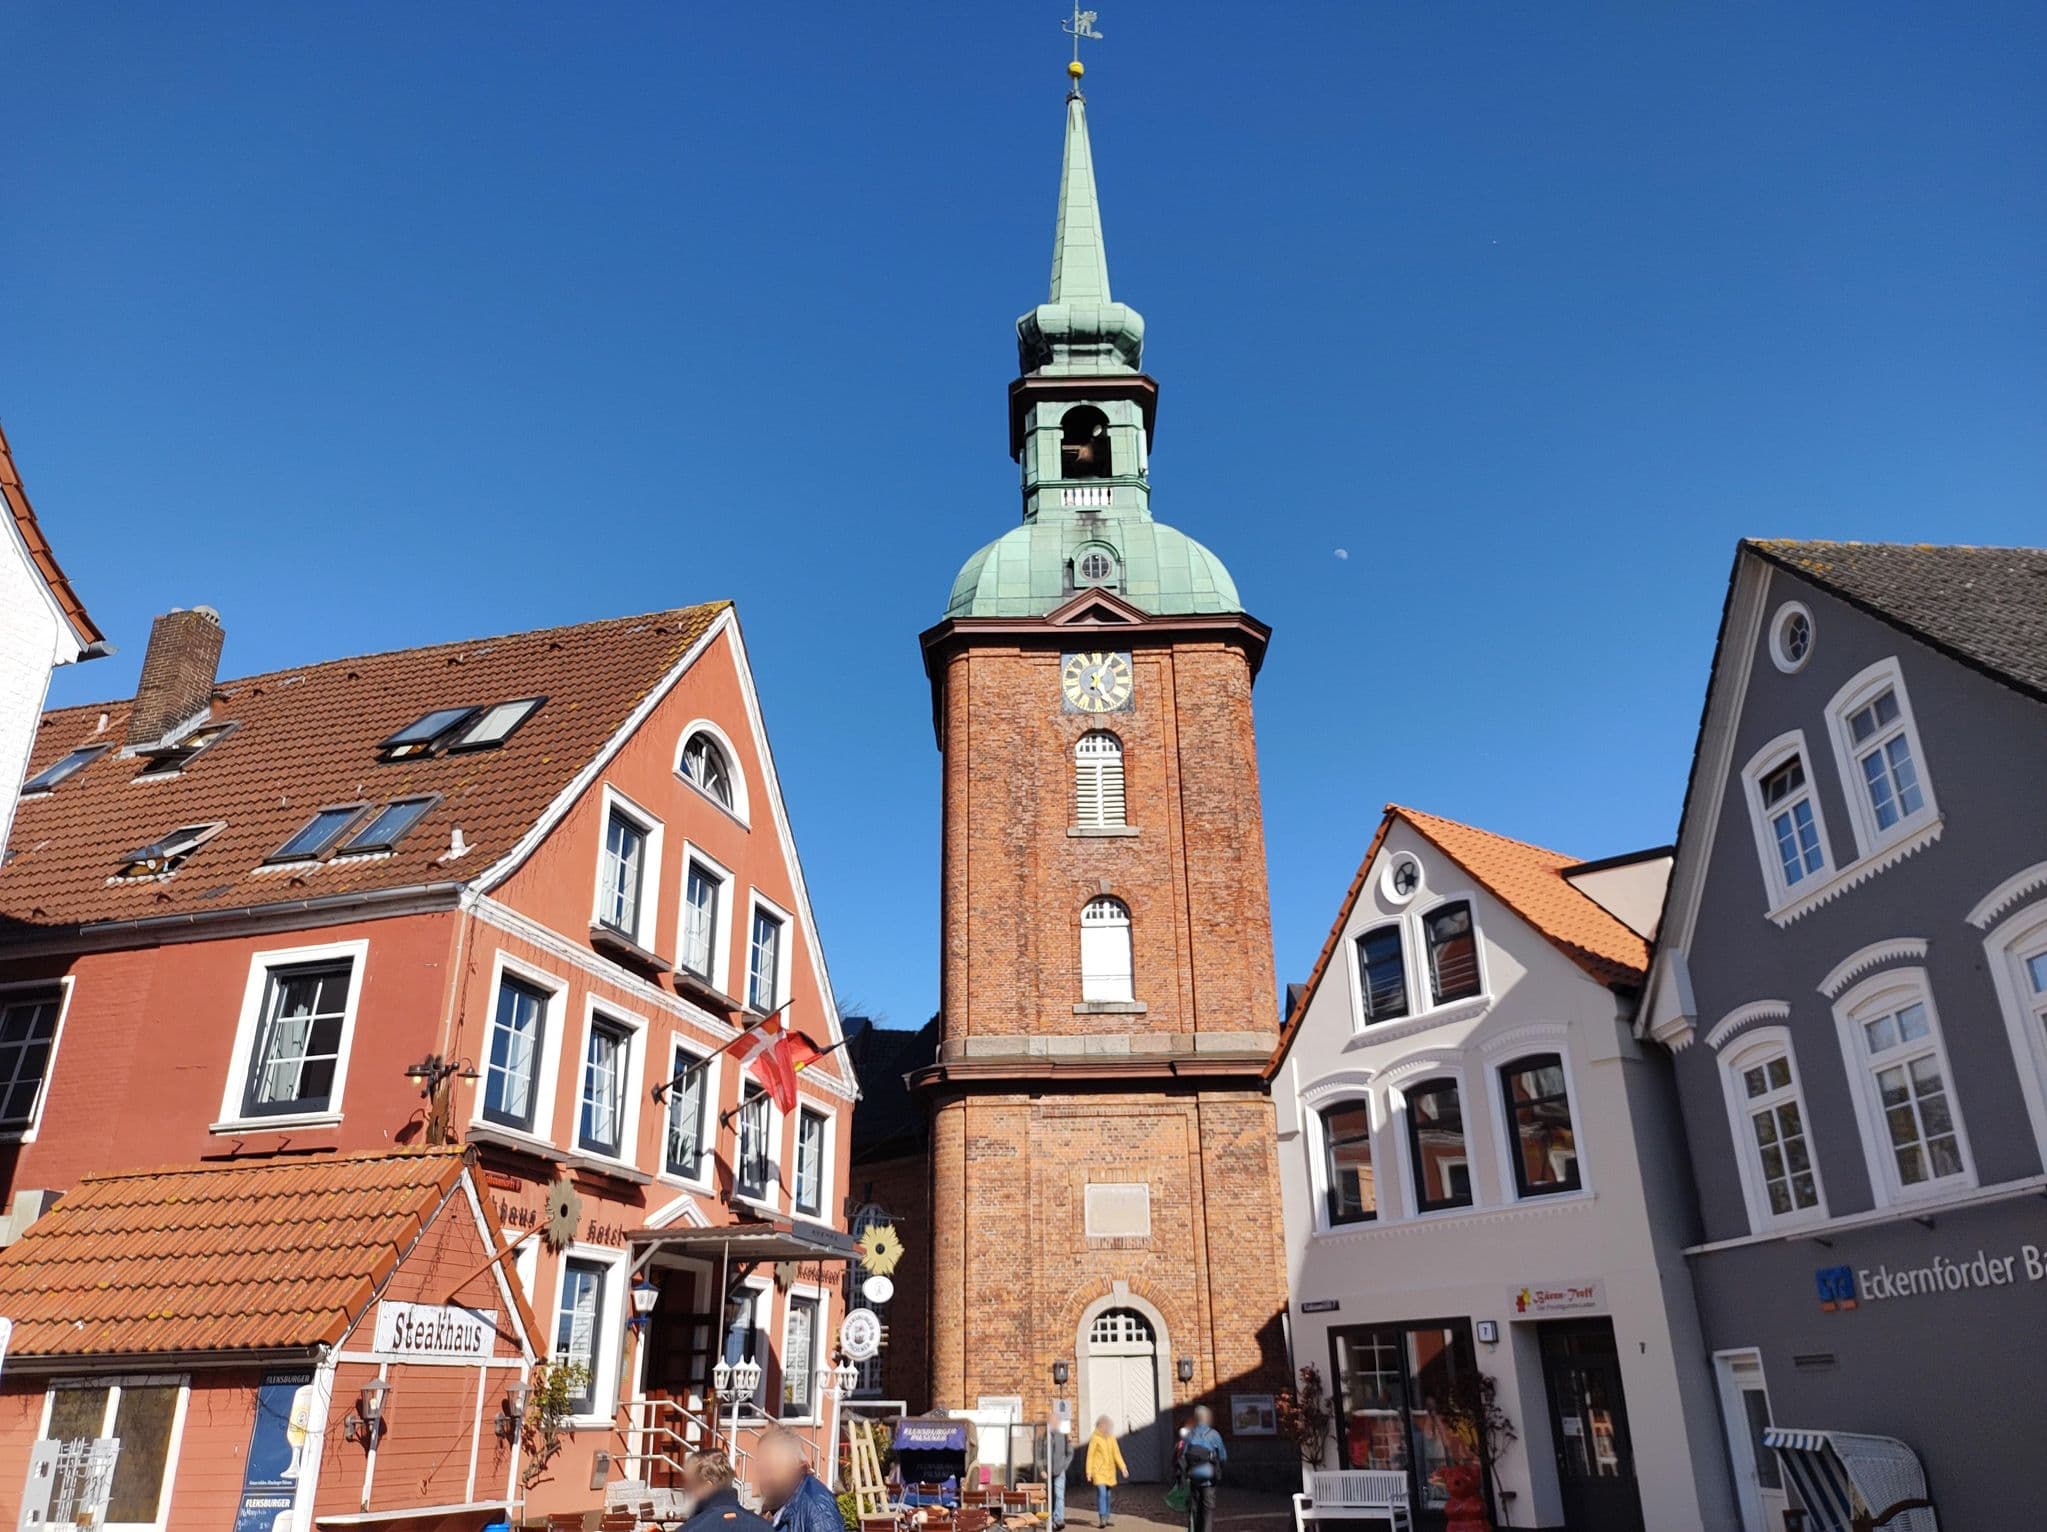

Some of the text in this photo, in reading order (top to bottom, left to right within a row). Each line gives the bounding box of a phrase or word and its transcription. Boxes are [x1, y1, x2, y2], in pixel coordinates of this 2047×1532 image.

[2022, 1245, 2047, 1281] B
[393, 1312, 482, 1352] Steakhaus
[266, 1375, 310, 1384] FLENSBURGER
[246, 1499, 291, 1508] FLENSBURGER
